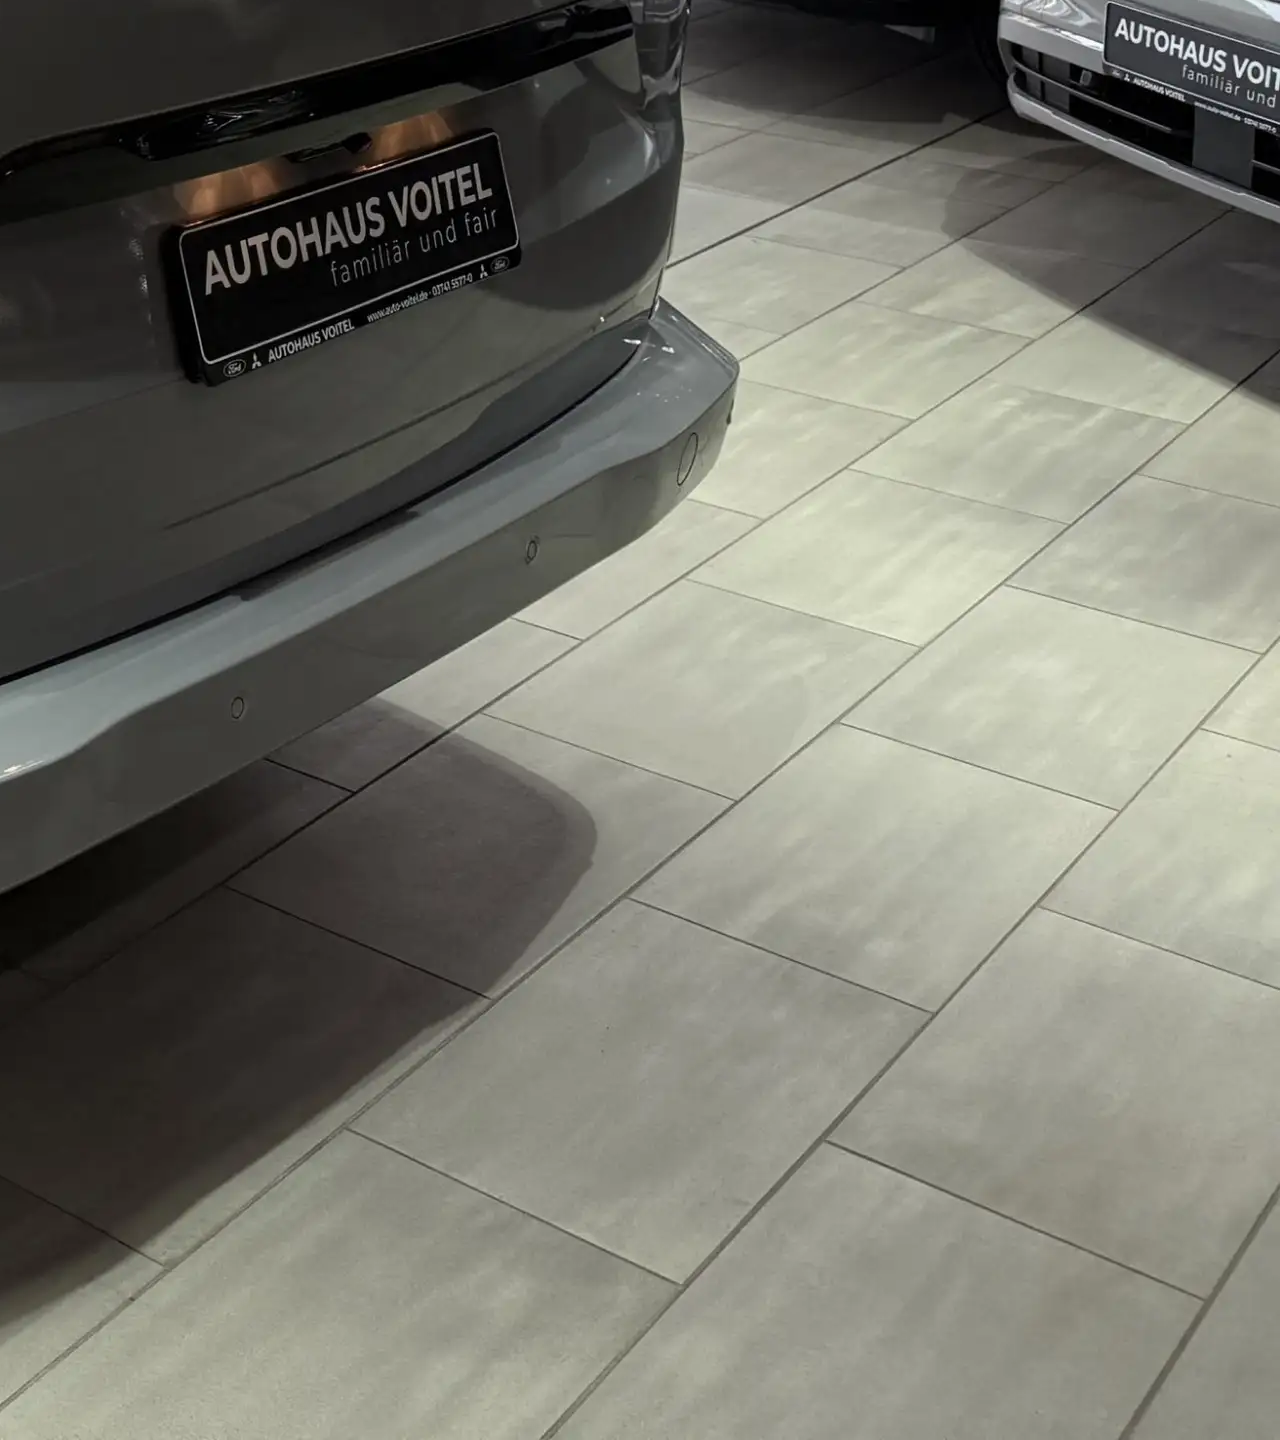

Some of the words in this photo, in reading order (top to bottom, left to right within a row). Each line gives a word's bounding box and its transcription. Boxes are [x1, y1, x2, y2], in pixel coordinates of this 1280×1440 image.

[1114, 17, 1228, 73] AUTOHAUS
[1246, 90, 1277, 109] und
[205, 196, 386, 296] AUTOHAUS
[387, 162, 493, 229] VOITEL
[330, 239, 410, 287] familiär
[419, 221, 458, 254] und
[464, 207, 498, 237] fair
[268, 331, 322, 363] AUTOHAUS
[321, 318, 356, 341] VOITEL
